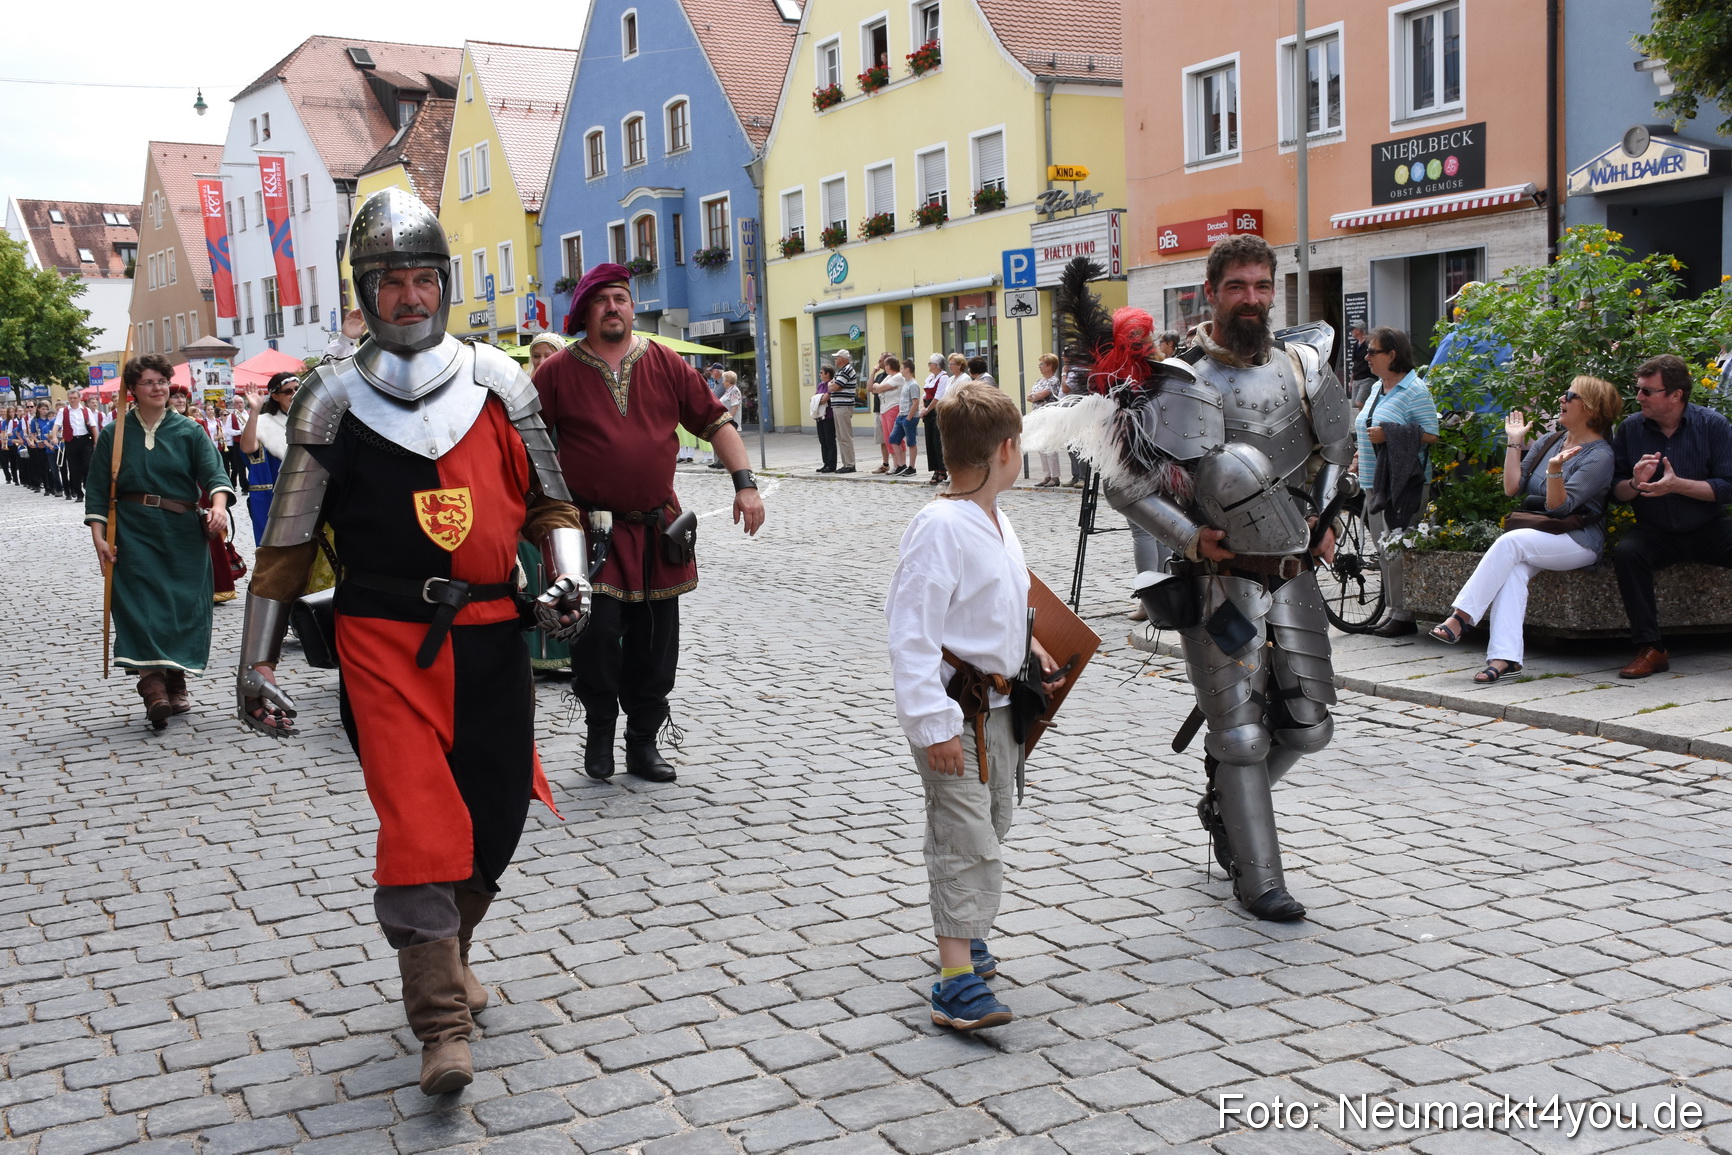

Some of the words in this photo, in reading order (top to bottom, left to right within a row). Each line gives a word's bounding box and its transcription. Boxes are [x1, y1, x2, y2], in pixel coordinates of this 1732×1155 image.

[1381, 129, 1474, 161] NIEßLBECK
[263, 161, 278, 197] K&L
[1056, 167, 1074, 178] KINO
[1589, 154, 1684, 187] MÜHLBAUER
[1390, 188, 1413, 198] OBST
[1416, 186, 1422, 194] &
[1425, 179, 1464, 193] GEMÜSE
[1236, 217, 1257, 230] DER
[1044, 244, 1072, 261] RIALTO
[1075, 240, 1096, 256] KINO
[1111, 213, 1120, 275] KINO
[1159, 234, 1179, 250] DER
[1310, 246, 1317, 255] 15
[829, 257, 845, 286] FASS
[1010, 253, 1029, 285] P
[487, 278, 493, 298] P
[528, 296, 534, 317] P
